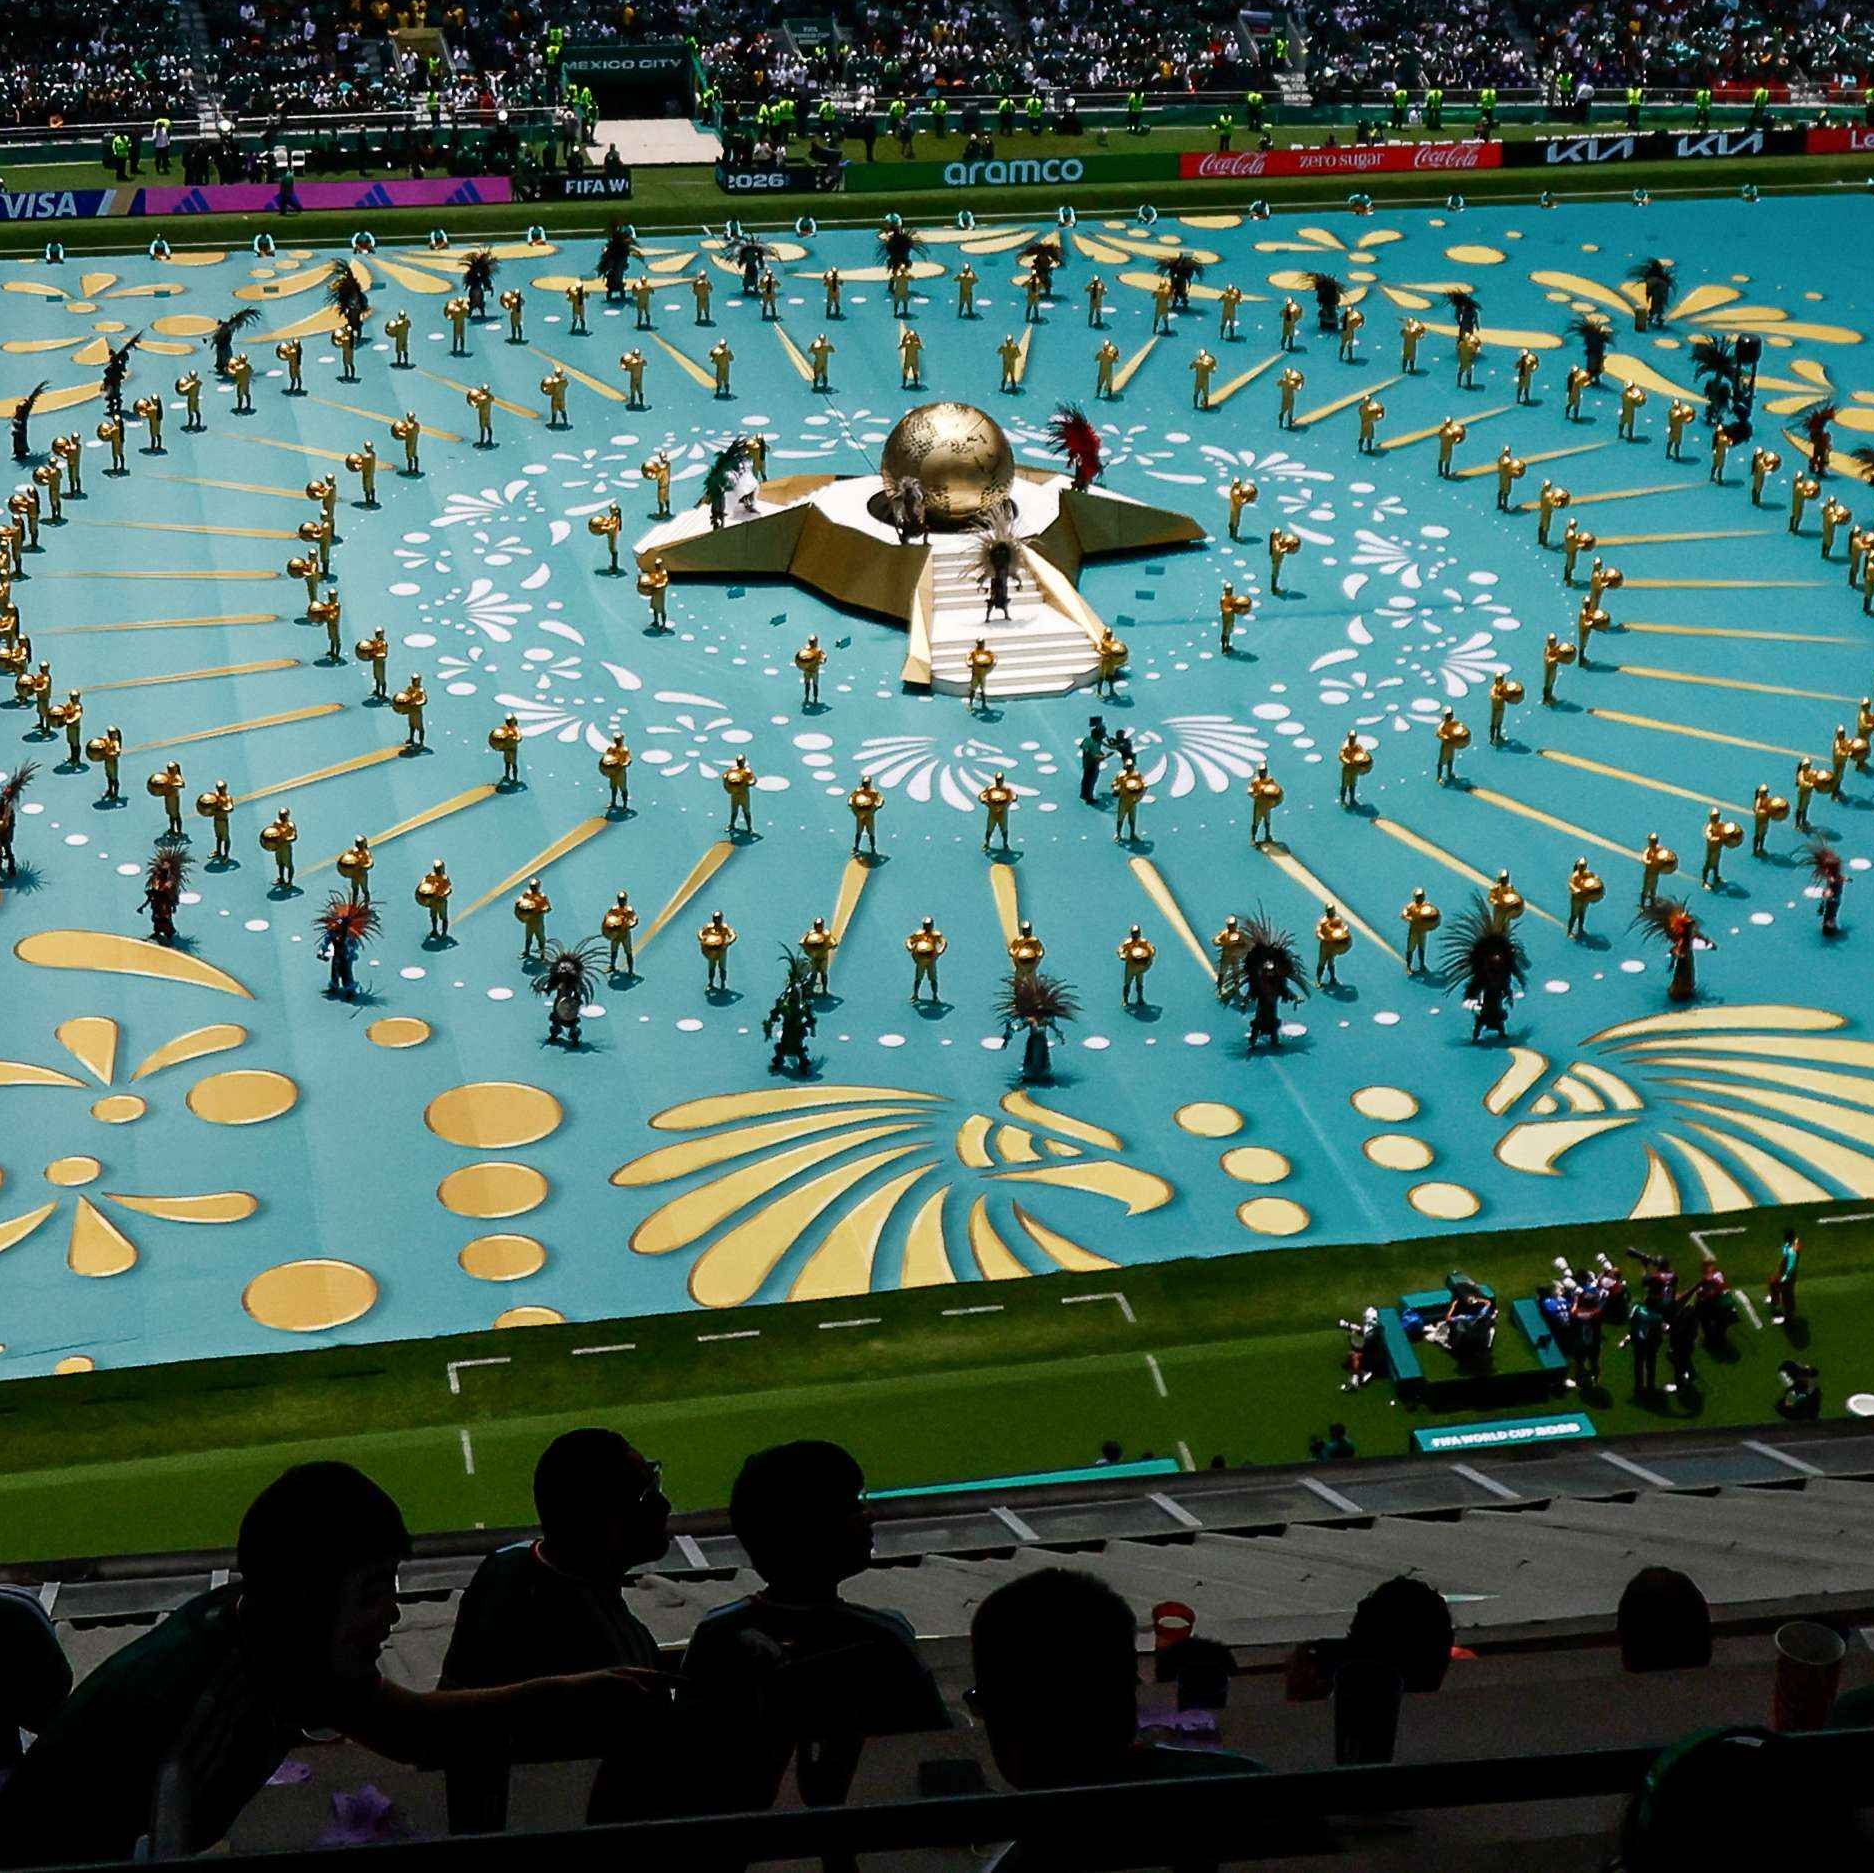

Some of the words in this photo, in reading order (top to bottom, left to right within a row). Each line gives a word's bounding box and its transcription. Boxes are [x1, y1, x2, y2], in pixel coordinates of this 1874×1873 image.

[561, 60, 635, 72] MEXICO
[638, 58, 683, 71] CITY
[1546, 134, 1638, 165] KIA
[1676, 131, 1764, 158] KIA
[943, 158, 1085, 186] aramco
[1299, 153, 1333, 170] zero
[1336, 149, 1385, 172] sugar
[565, 179, 605, 196] FIFA
[1460, 1431, 1507, 1445] WORLD
[1508, 1428, 1534, 1441] CUP
